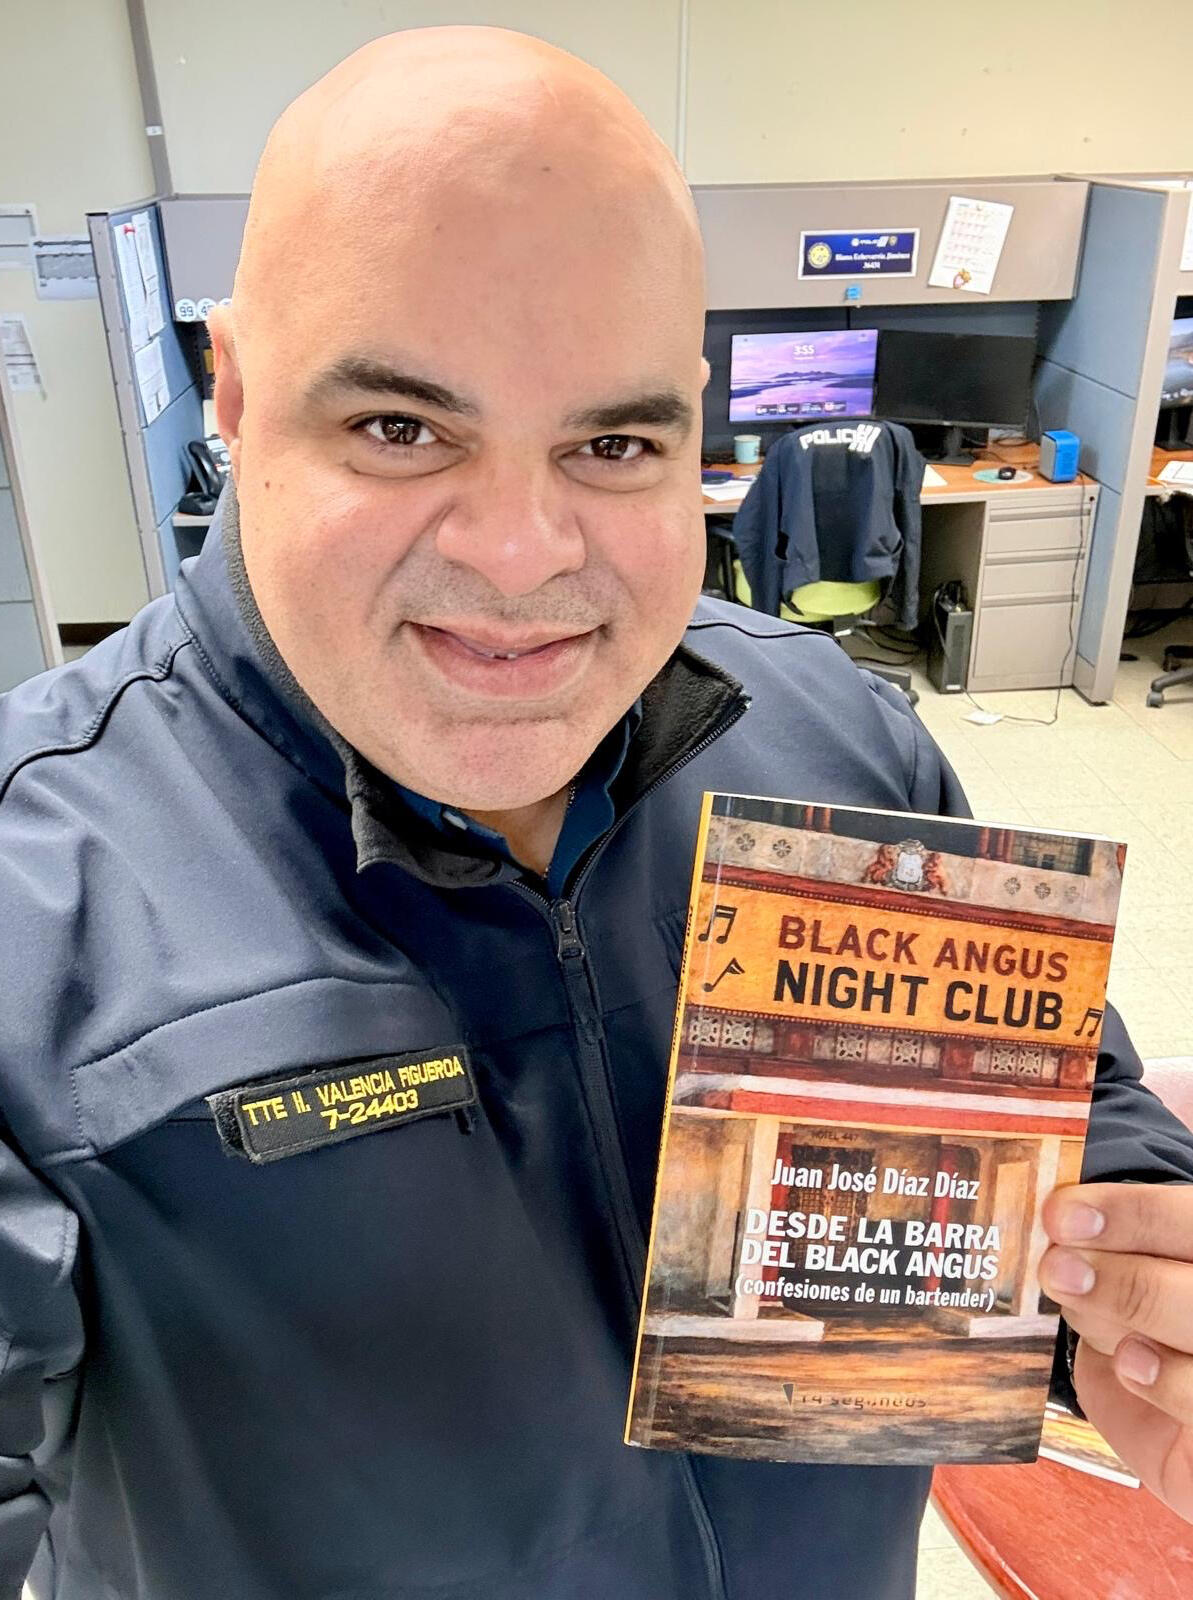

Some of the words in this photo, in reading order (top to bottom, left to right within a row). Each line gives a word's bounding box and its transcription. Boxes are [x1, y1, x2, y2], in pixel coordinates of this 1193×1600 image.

[778, 914, 921, 965] BLACK
[934, 937, 1069, 982] ANGUS
[773, 959, 929, 1016] NIGHT
[945, 980, 1064, 1031] CLUB
[242, 1096, 288, 1126] TTE
[316, 1070, 396, 1107] VALENCIA
[397, 1055, 465, 1088] FIGUEROA
[320, 1088, 419, 1131] 7-24403
[770, 1158, 824, 1189] Juan
[827, 1163, 877, 1194] José
[883, 1167, 930, 1197] Díaz
[933, 1171, 981, 1201] Díaz
[745, 1208, 847, 1242] DESDE
[856, 1217, 894, 1246] LA
[904, 1219, 1002, 1251] BARRA
[740, 1239, 796, 1270] DEL
[804, 1244, 900, 1276] BLACK
[905, 1250, 999, 1281] ANGUS
[735, 1273, 850, 1303] (confesiones
[855, 1281, 875, 1304] de
[879, 1286, 901, 1305] un
[904, 1284, 997, 1313] bartender)
